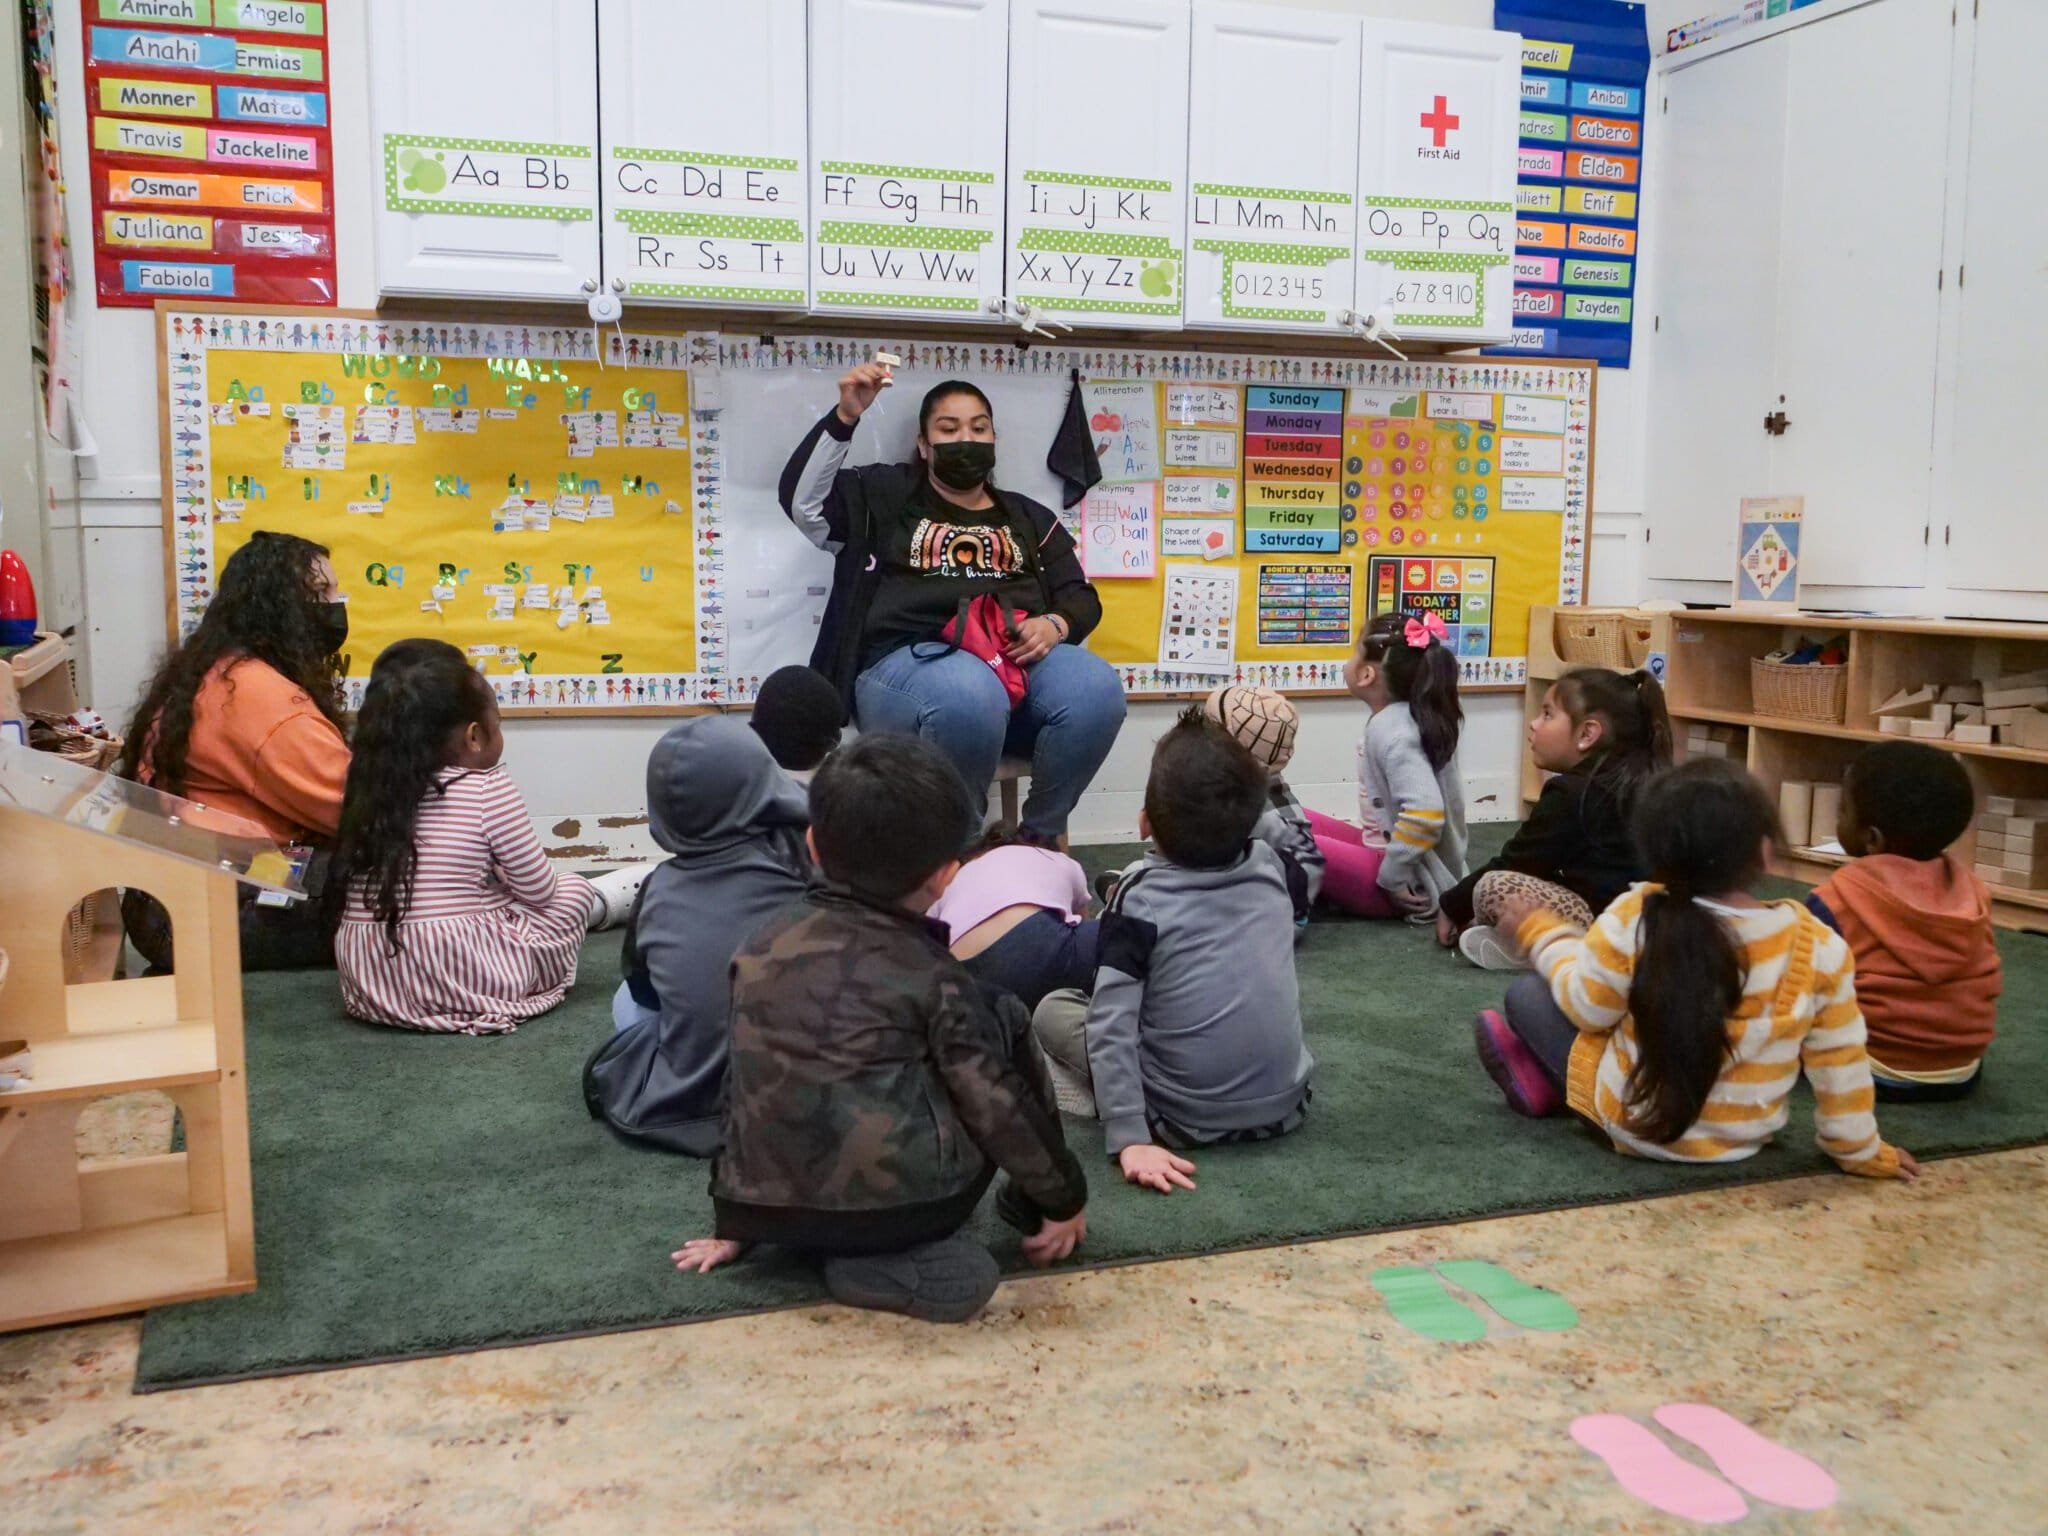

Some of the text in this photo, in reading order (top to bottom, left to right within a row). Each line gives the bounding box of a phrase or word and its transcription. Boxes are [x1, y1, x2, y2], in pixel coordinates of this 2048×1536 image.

[120, 0, 193, 18] Amirah
[240, 3, 305, 26] Angelo
[128, 37, 198, 61] Anahi
[1521, 49, 1559, 63] raceli
[236, 49, 301, 71] Ermias
[121, 88, 195, 107] Monner
[1590, 90, 1627, 106] Anibal
[120, 128, 182, 149] Travis
[1577, 121, 1631, 141] Cubero
[217, 139, 309, 161] Jackeline
[1418, 147, 1461, 160] First Aid
[452, 154, 569, 190] Aa Bb
[1580, 158, 1624, 178] Elden
[131, 178, 197, 197] Osmar
[618, 163, 779, 201] Cc Dd Ee
[243, 185, 294, 204] Erick
[825, 175, 978, 222] Ff Gg Hh
[1583, 192, 1615, 212] Enif
[1030, 184, 1150, 229] Ii Jj Kk
[1195, 196, 1336, 232] Ll Mm Nn
[117, 217, 203, 240] Juliana
[1369, 209, 1503, 251] Oo Pp Qq
[1517, 227, 1543, 241] Noe
[1579, 231, 1624, 250] Rodolfo
[639, 237, 784, 273] Rr Ss Tt
[821, 246, 974, 282] Uu Vv Ww
[140, 269, 210, 287] Fabiola
[1018, 252, 1133, 296] Xx Yy Zz
[1573, 265, 1620, 283] Genesis
[1576, 299, 1621, 318] Jayden
[342, 354, 568, 382] WORD WALL
[364, 382, 399, 405] Cc
[433, 383, 468, 407] Dd
[506, 384, 537, 409] Ee
[623, 387, 656, 412] Gg
[1094, 385, 1144, 396] Alliteration
[1269, 392, 1320, 408] Sunday
[1364, 399, 1379, 408] May
[1432, 408, 1450, 416] year
[1266, 416, 1321, 431] Monday
[1265, 440, 1322, 456] Tuesday
[1253, 464, 1333, 479] Wednesday
[1504, 459, 1522, 467] today
[228, 475, 265, 499] Hh
[1099, 485, 1135, 496] Rhyming
[1260, 487, 1324, 502] Thursday
[1269, 511, 1314, 526] Friday
[1164, 528, 1189, 536] Shape
[1260, 534, 1324, 549] Saturday
[366, 563, 404, 588] Qq
[504, 562, 533, 584] Ss
[1407, 595, 1457, 607] TODAY'S
